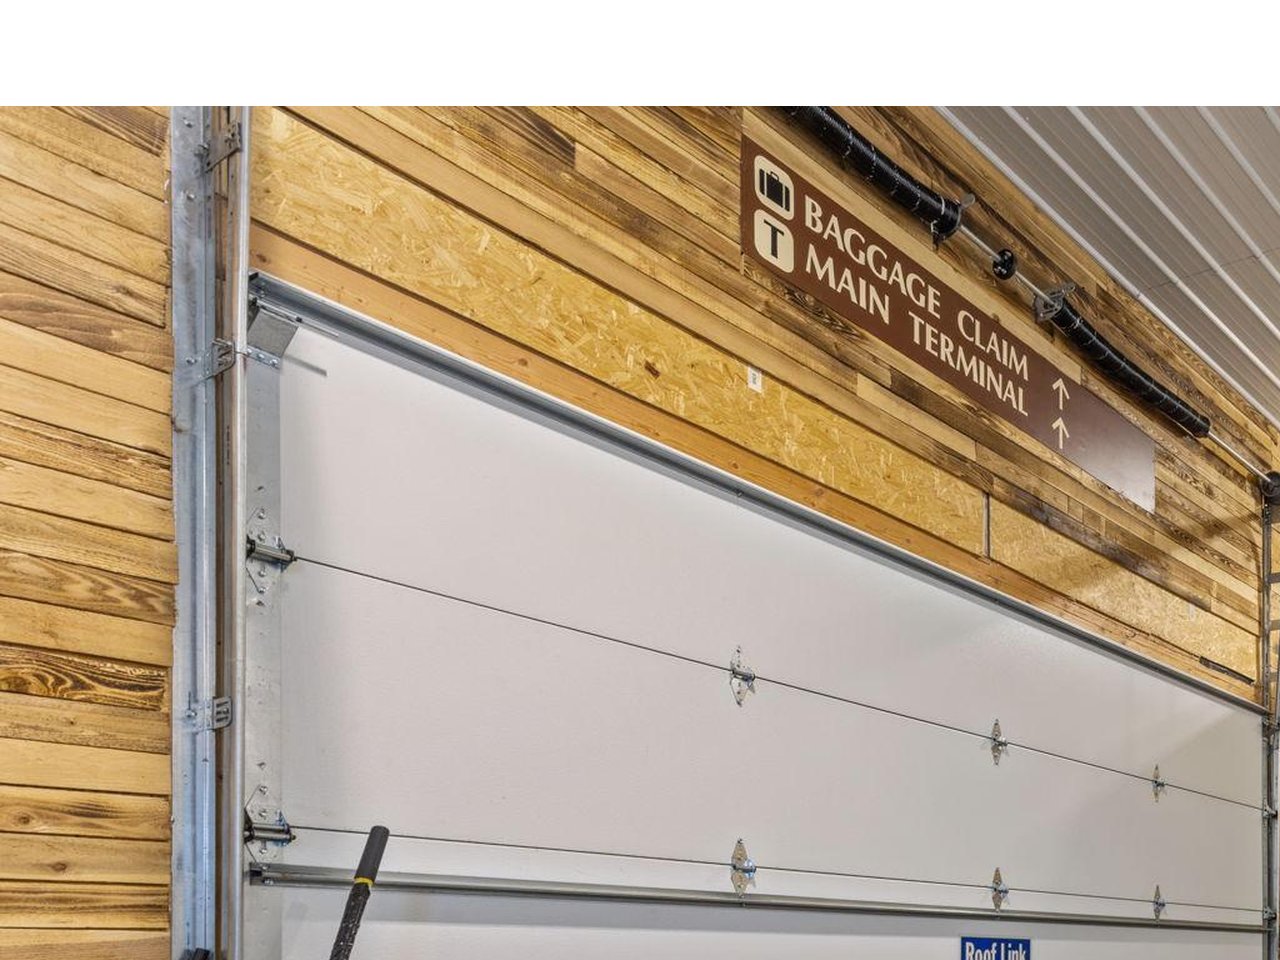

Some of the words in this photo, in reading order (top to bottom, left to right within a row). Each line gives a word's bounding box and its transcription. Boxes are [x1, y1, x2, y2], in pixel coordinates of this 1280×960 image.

[763, 219, 785, 259] T
[804, 195, 941, 320] BAGGAGE
[957, 310, 1029, 381] CLAIM
[806, 244, 890, 325] MAIN
[908, 311, 1029, 417] TERMINAL
